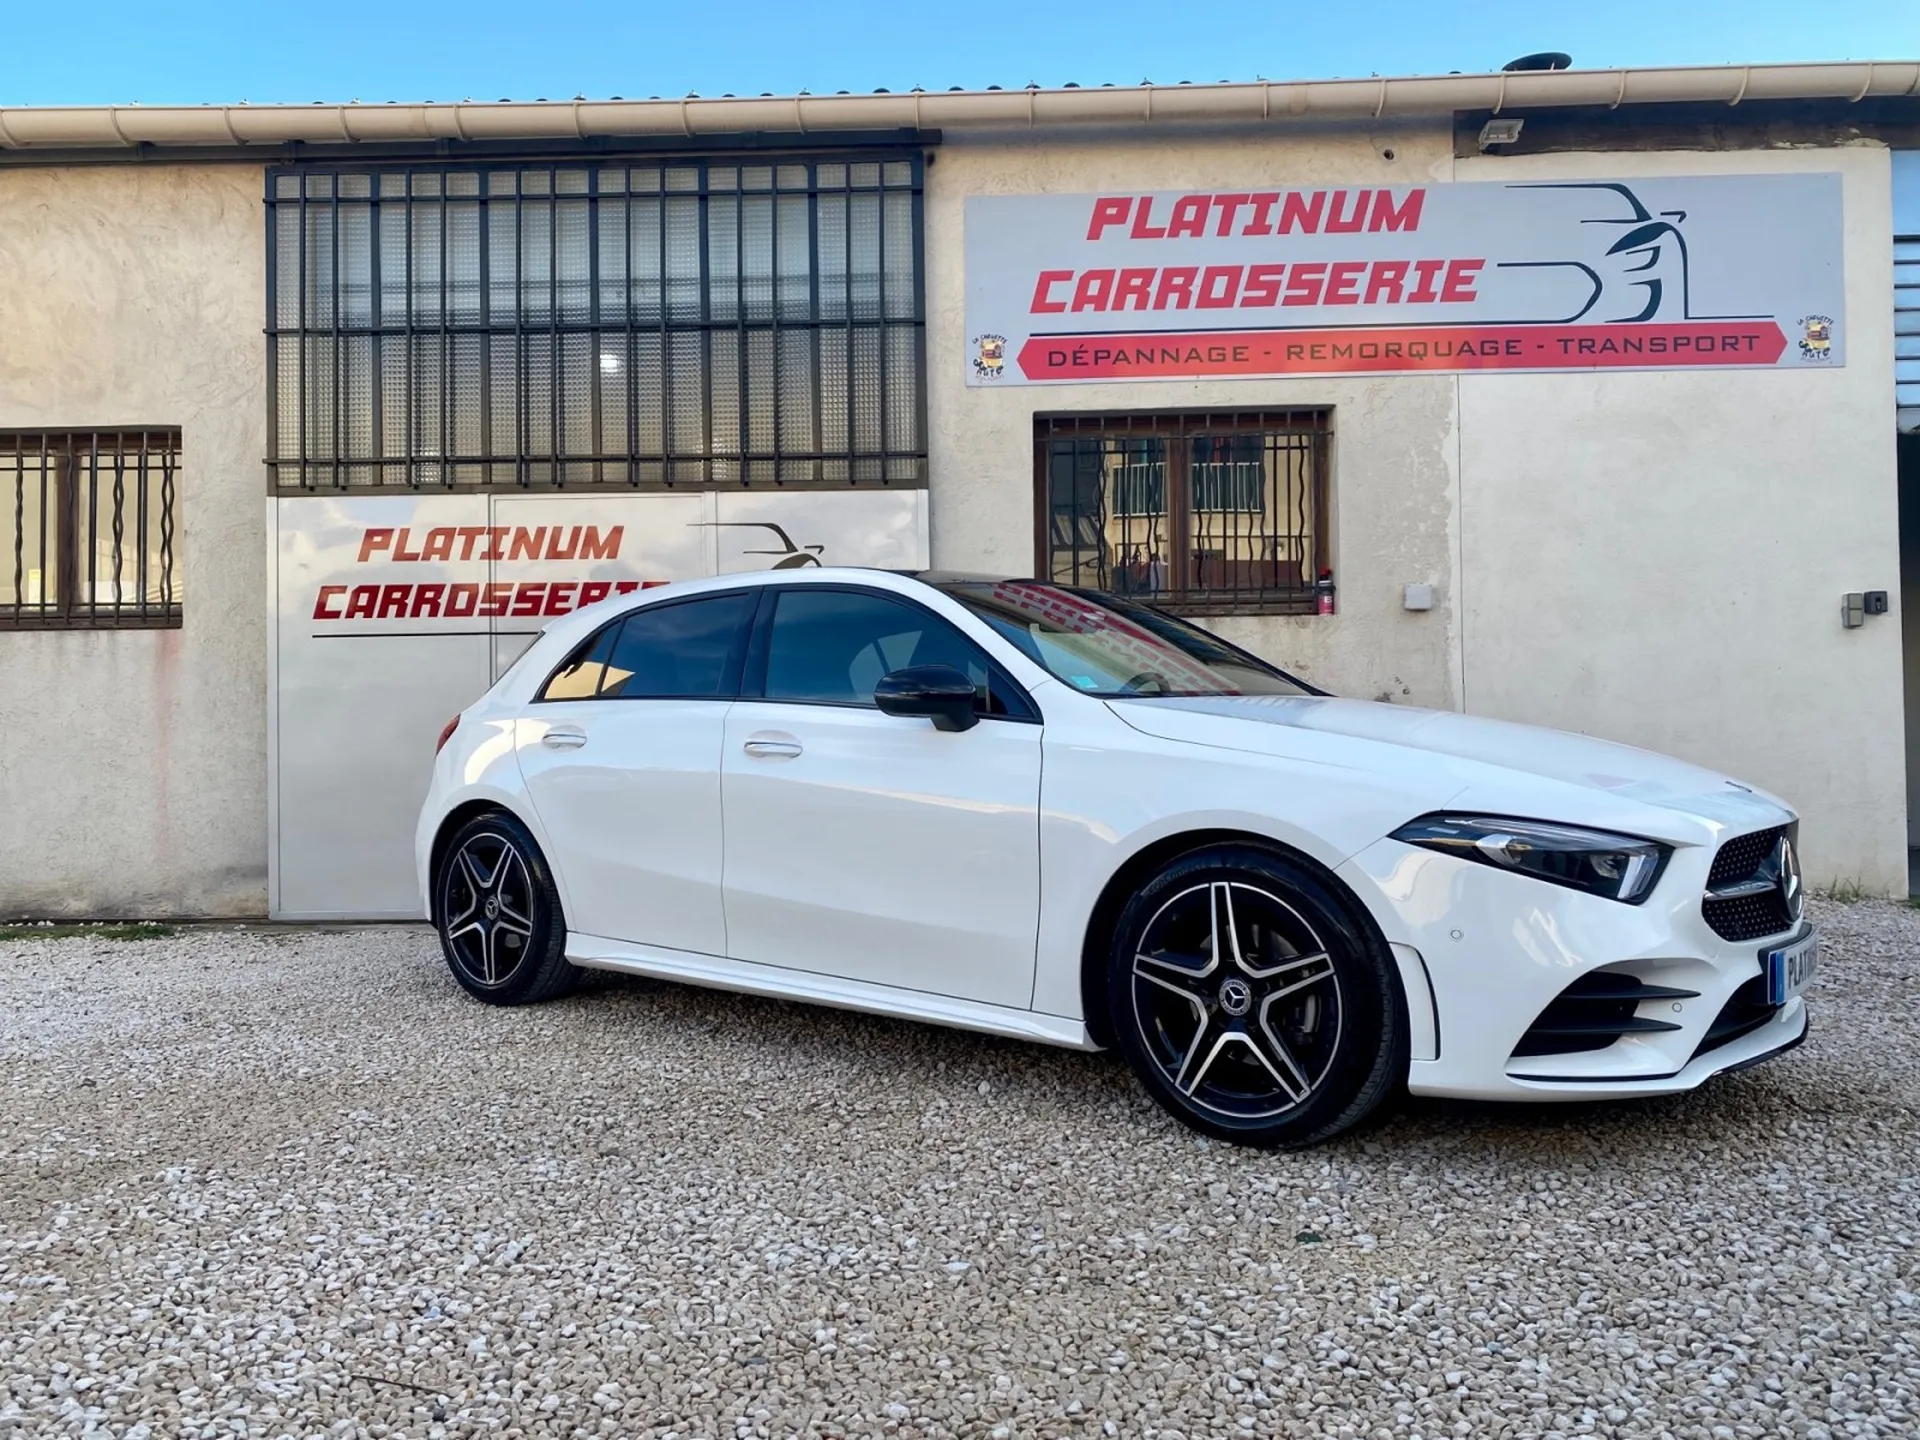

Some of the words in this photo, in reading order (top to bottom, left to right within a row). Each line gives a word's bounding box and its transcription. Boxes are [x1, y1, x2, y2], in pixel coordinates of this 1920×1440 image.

[1086, 188, 1425, 241] PLATINUM
[1030, 258, 1485, 314] CARROSSERIE
[1047, 343, 1250, 367] DÉPANNAGE
[1286, 338, 1523, 361] REMORQUAGE
[1556, 335, 1760, 354] TRANSPORT
[358, 525, 624, 562] PLATINUM
[312, 581, 671, 620] CARROSSER
